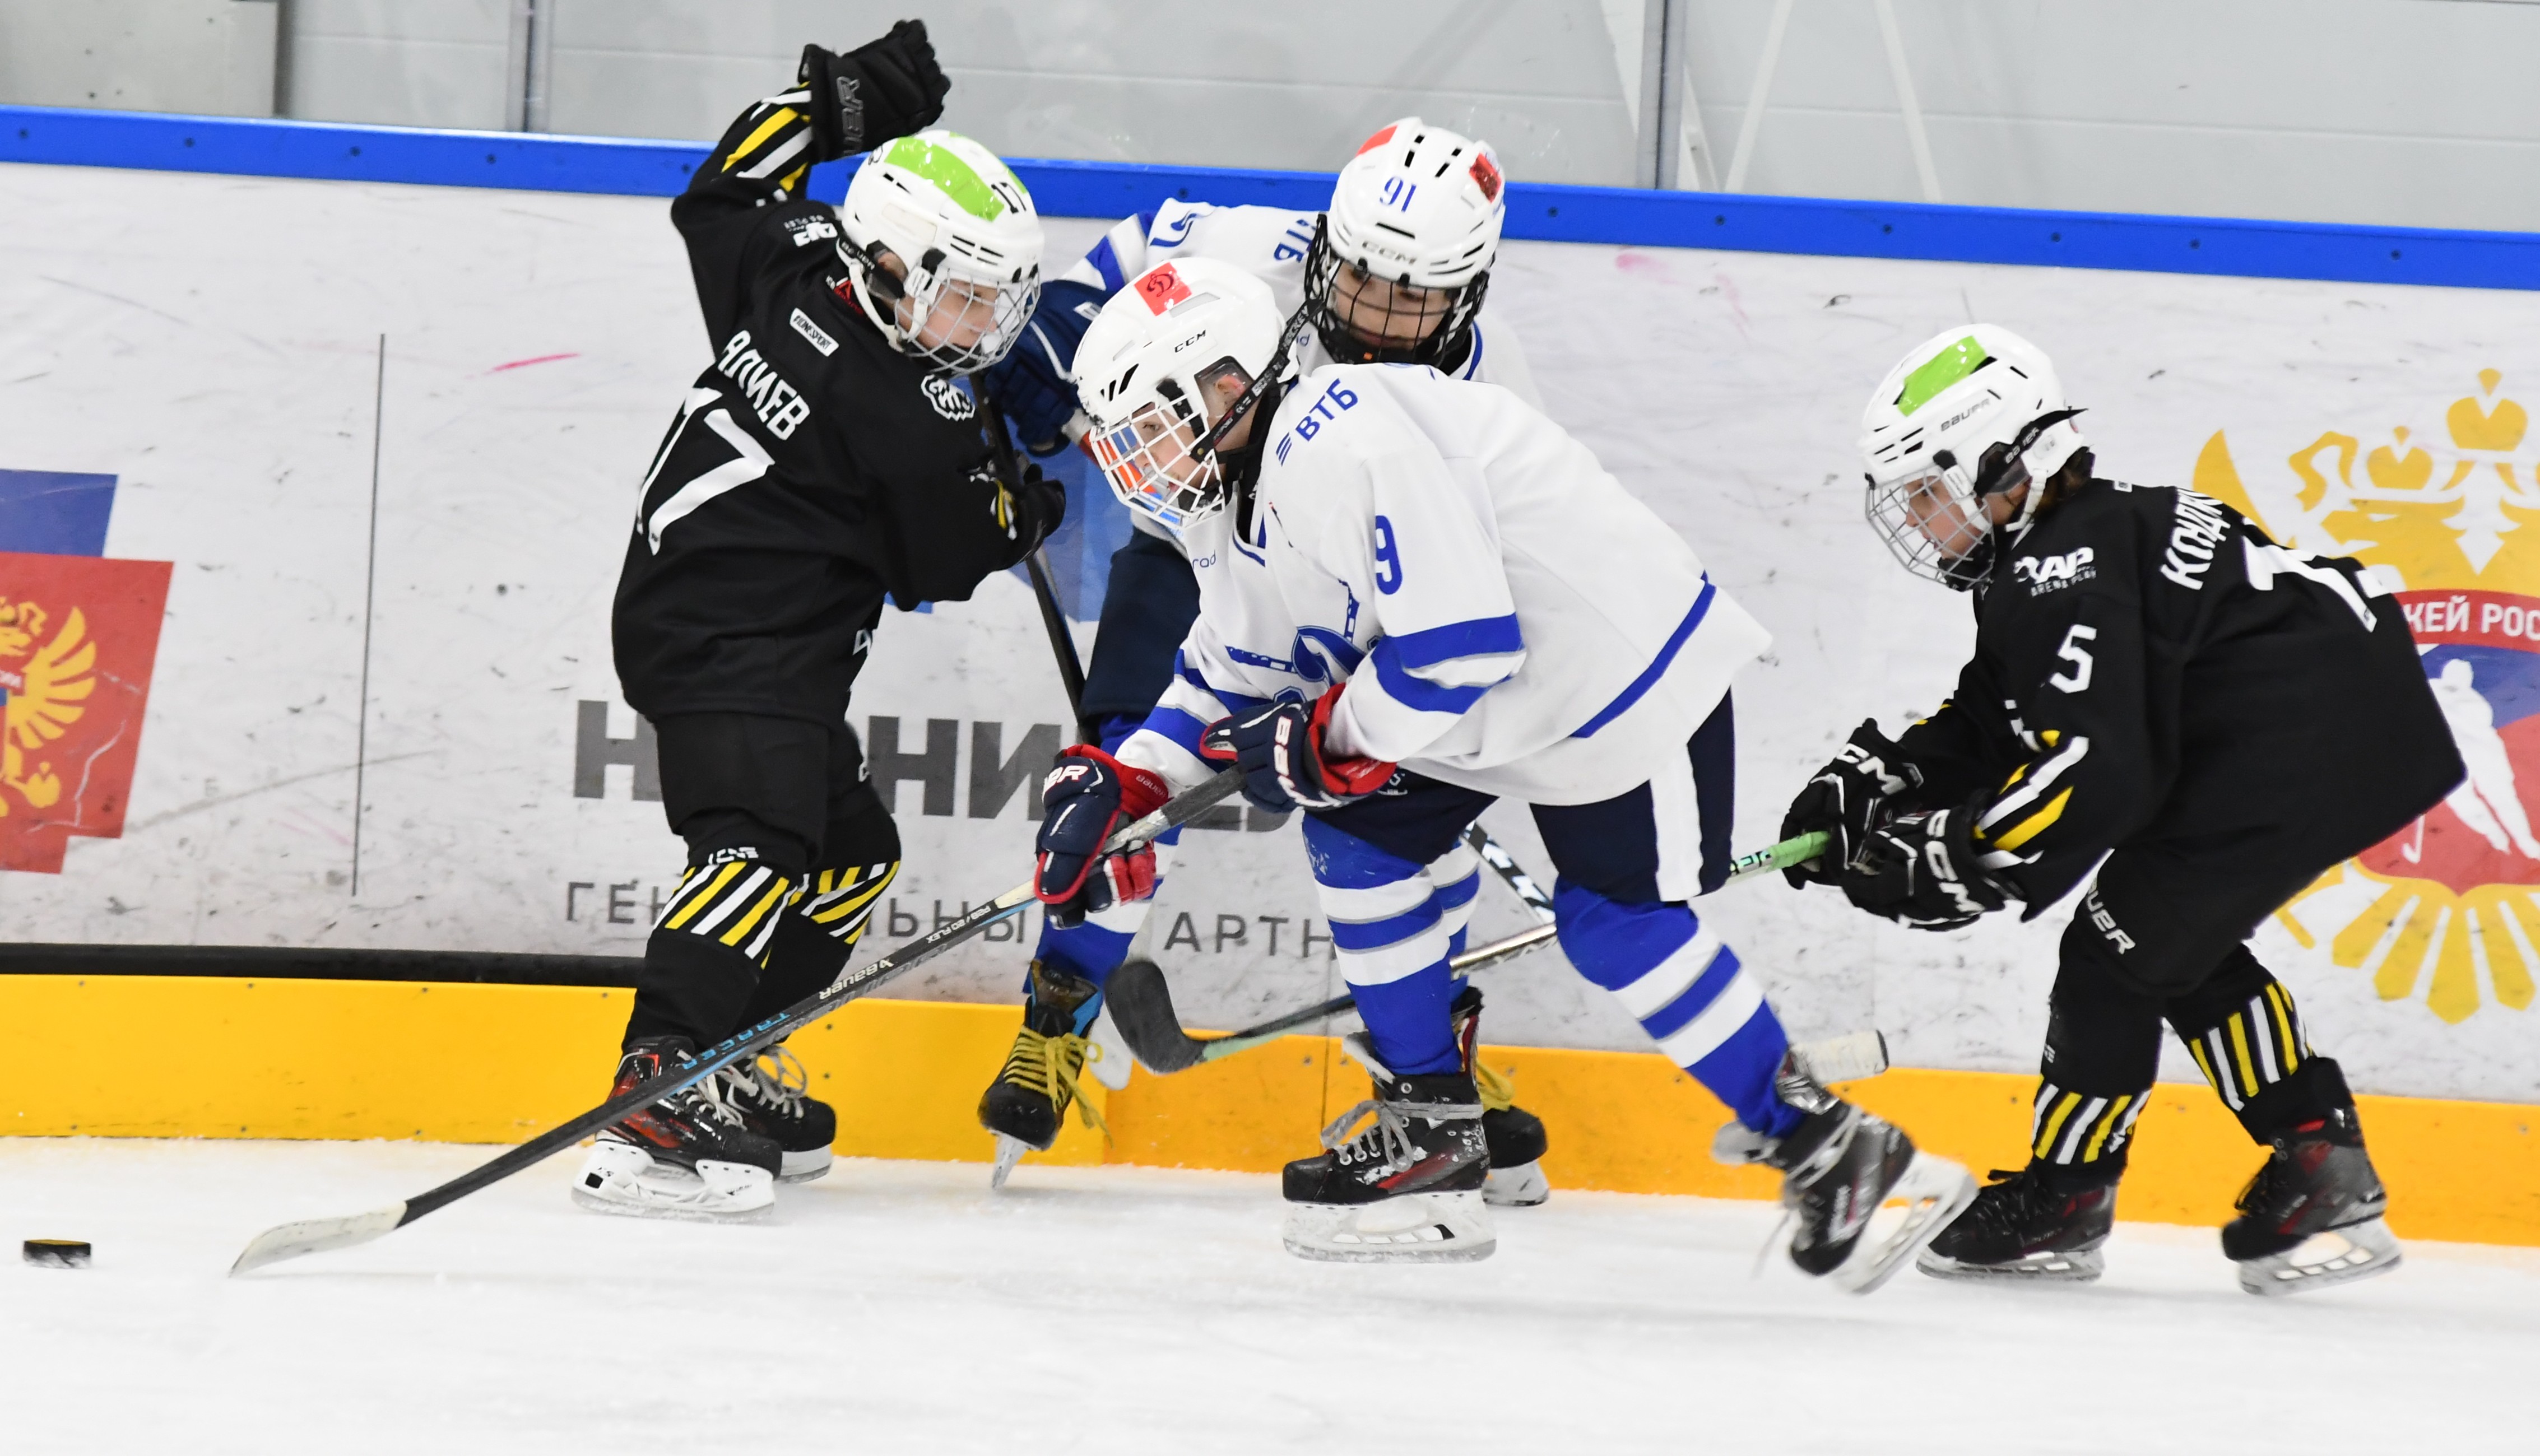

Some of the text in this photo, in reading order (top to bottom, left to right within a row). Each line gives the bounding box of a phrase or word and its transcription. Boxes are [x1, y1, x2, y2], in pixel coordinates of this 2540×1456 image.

[991, 181, 1026, 213] 17
[1380, 176, 1416, 212] 91
[1174, 329, 1206, 353] CCM
[1295, 378, 1358, 441] ВТБ
[637, 387, 776, 555] 17
[1375, 515, 1403, 595] 9
[2402, 595, 2470, 632] КЕЙ
[2050, 624, 2097, 694] 5
[926, 926, 952, 945] FLEX
[681, 1010, 791, 1070] TRACER
